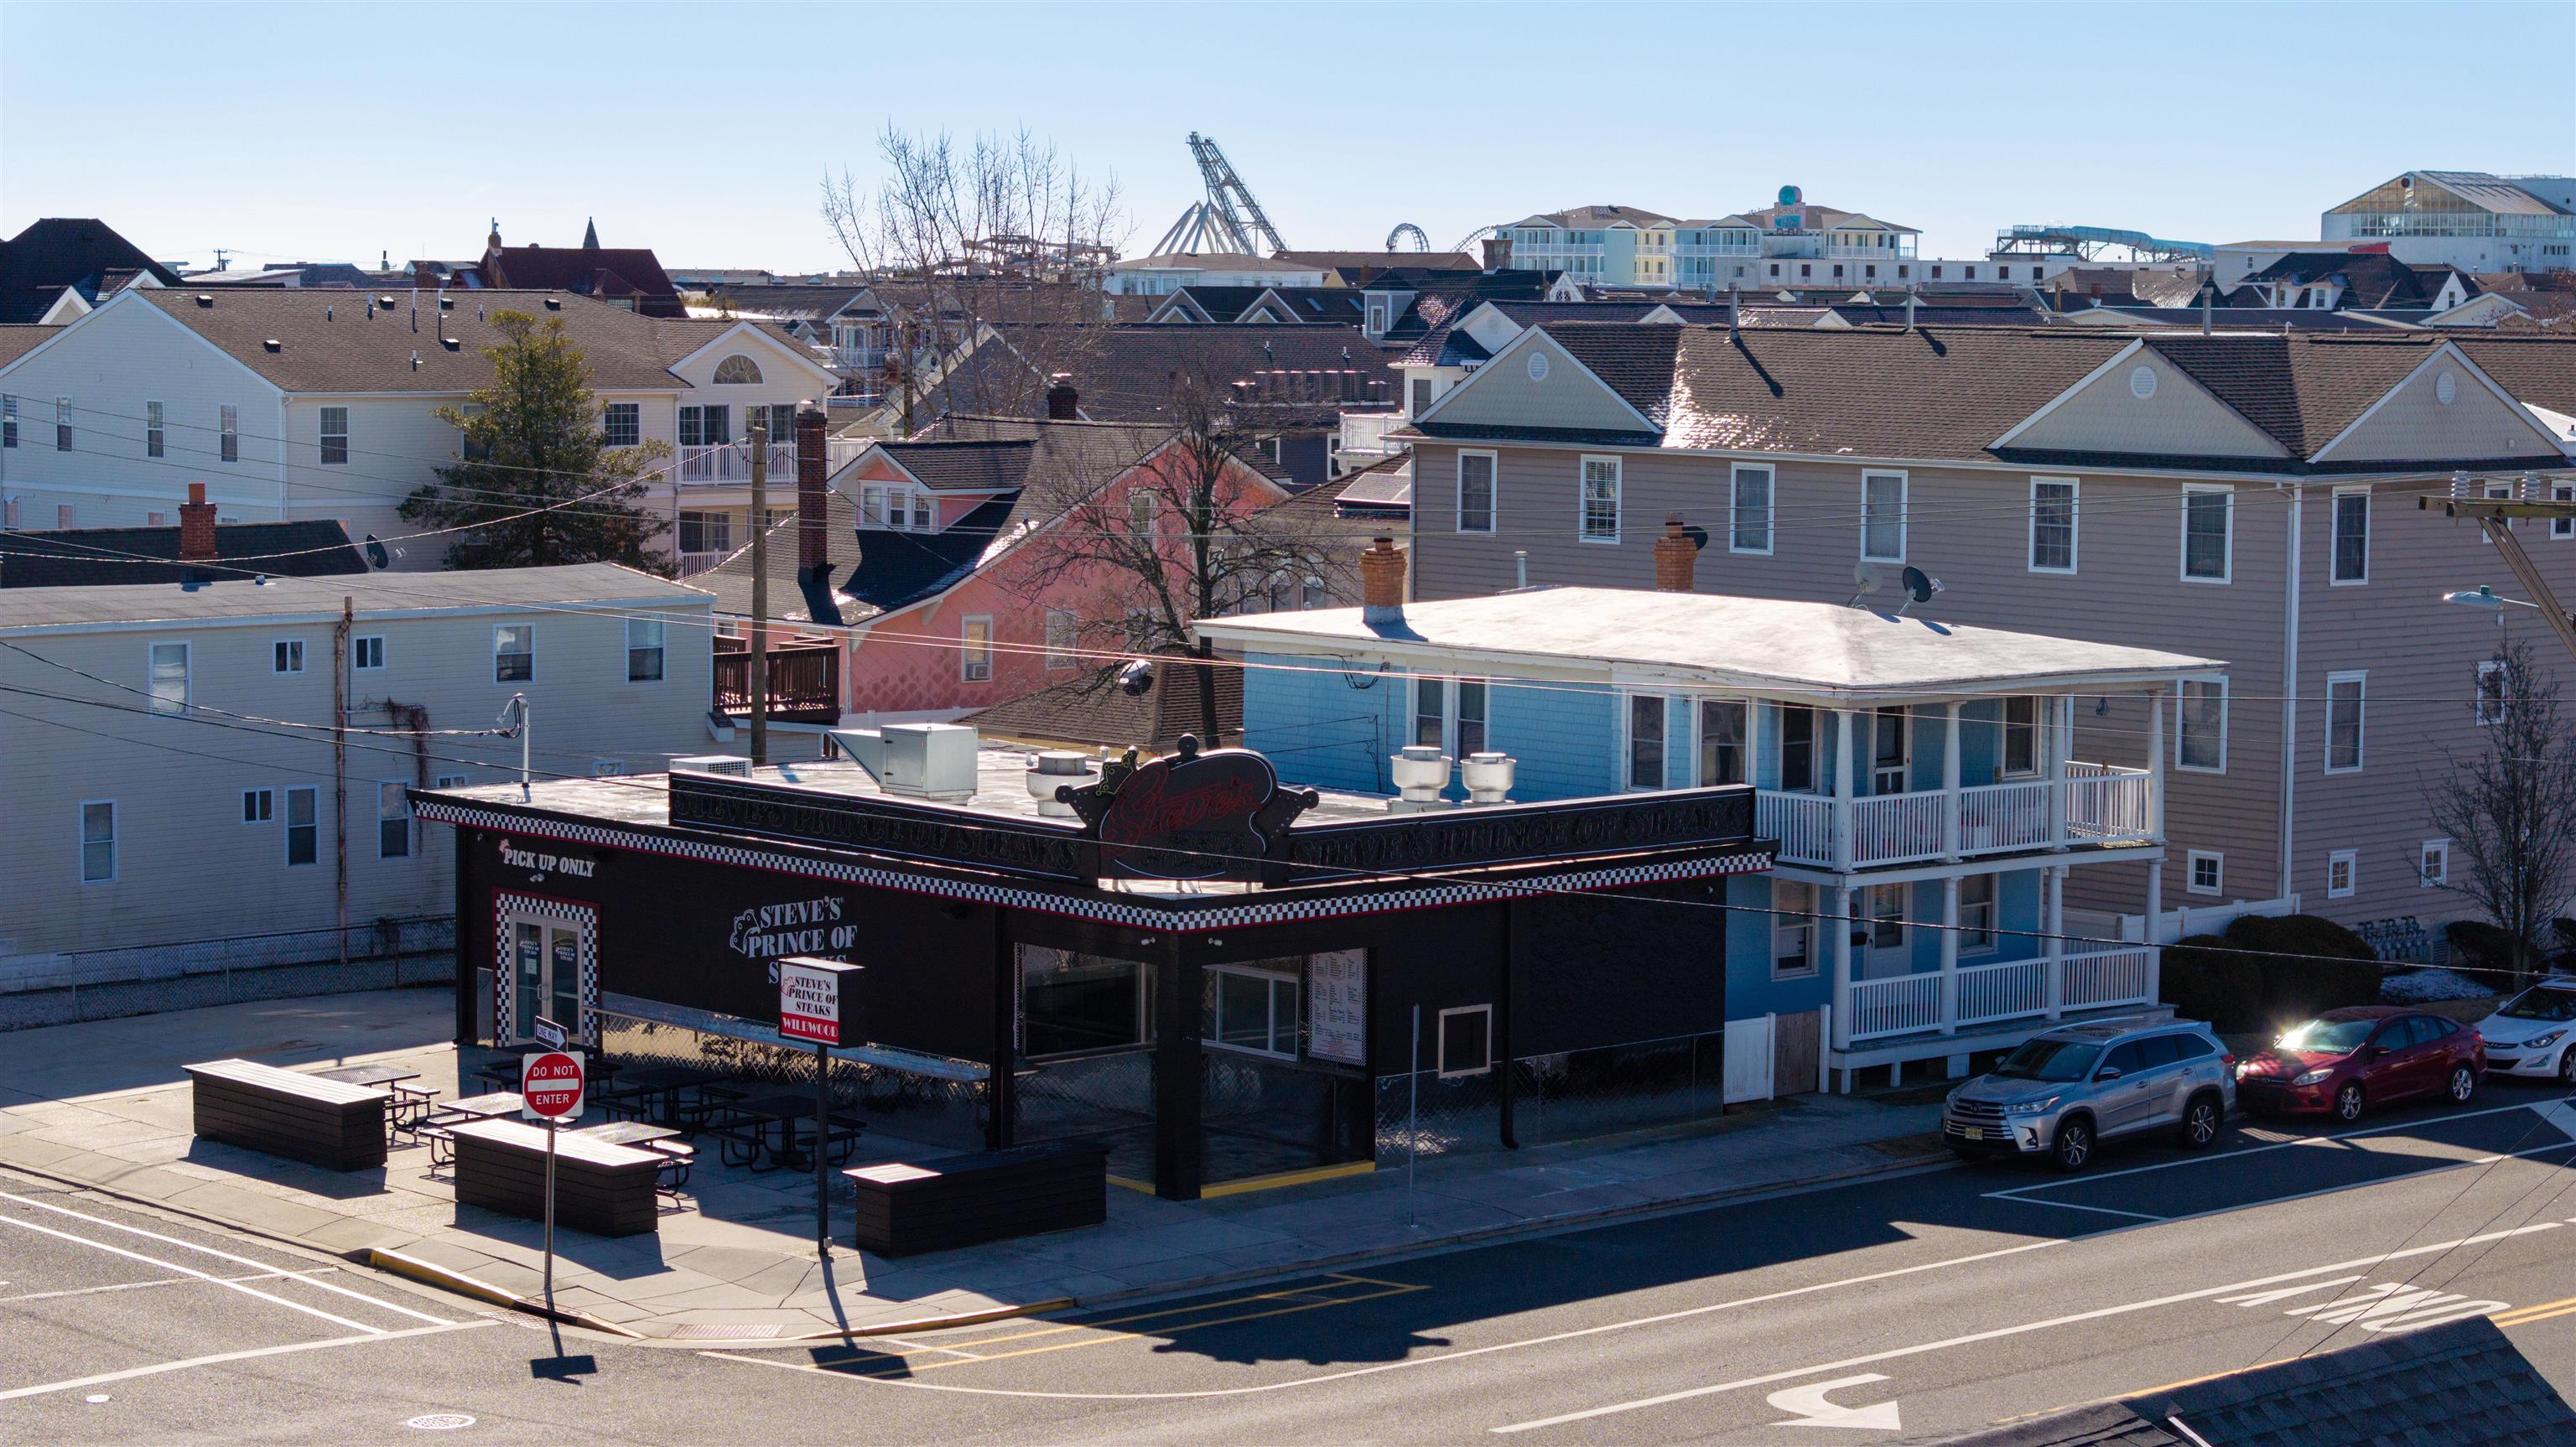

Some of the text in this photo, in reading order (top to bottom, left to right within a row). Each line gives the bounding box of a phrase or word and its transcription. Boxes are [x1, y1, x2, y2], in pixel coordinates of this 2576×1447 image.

[503, 848, 596, 877] PICK UP ONLY
[760, 895, 841, 928] STEVE'S
[748, 925, 858, 958] PRINCE OF
[795, 976, 831, 992] STEVE'S
[789, 988, 839, 1005] PRINCE OF
[795, 1001, 831, 1017] STEAKS
[538, 1025, 558, 1041] ONE WAY
[782, 1017, 839, 1037] WILDWOOD
[532, 1066, 574, 1077] DO NOT
[536, 1093, 569, 1105] ENTER
